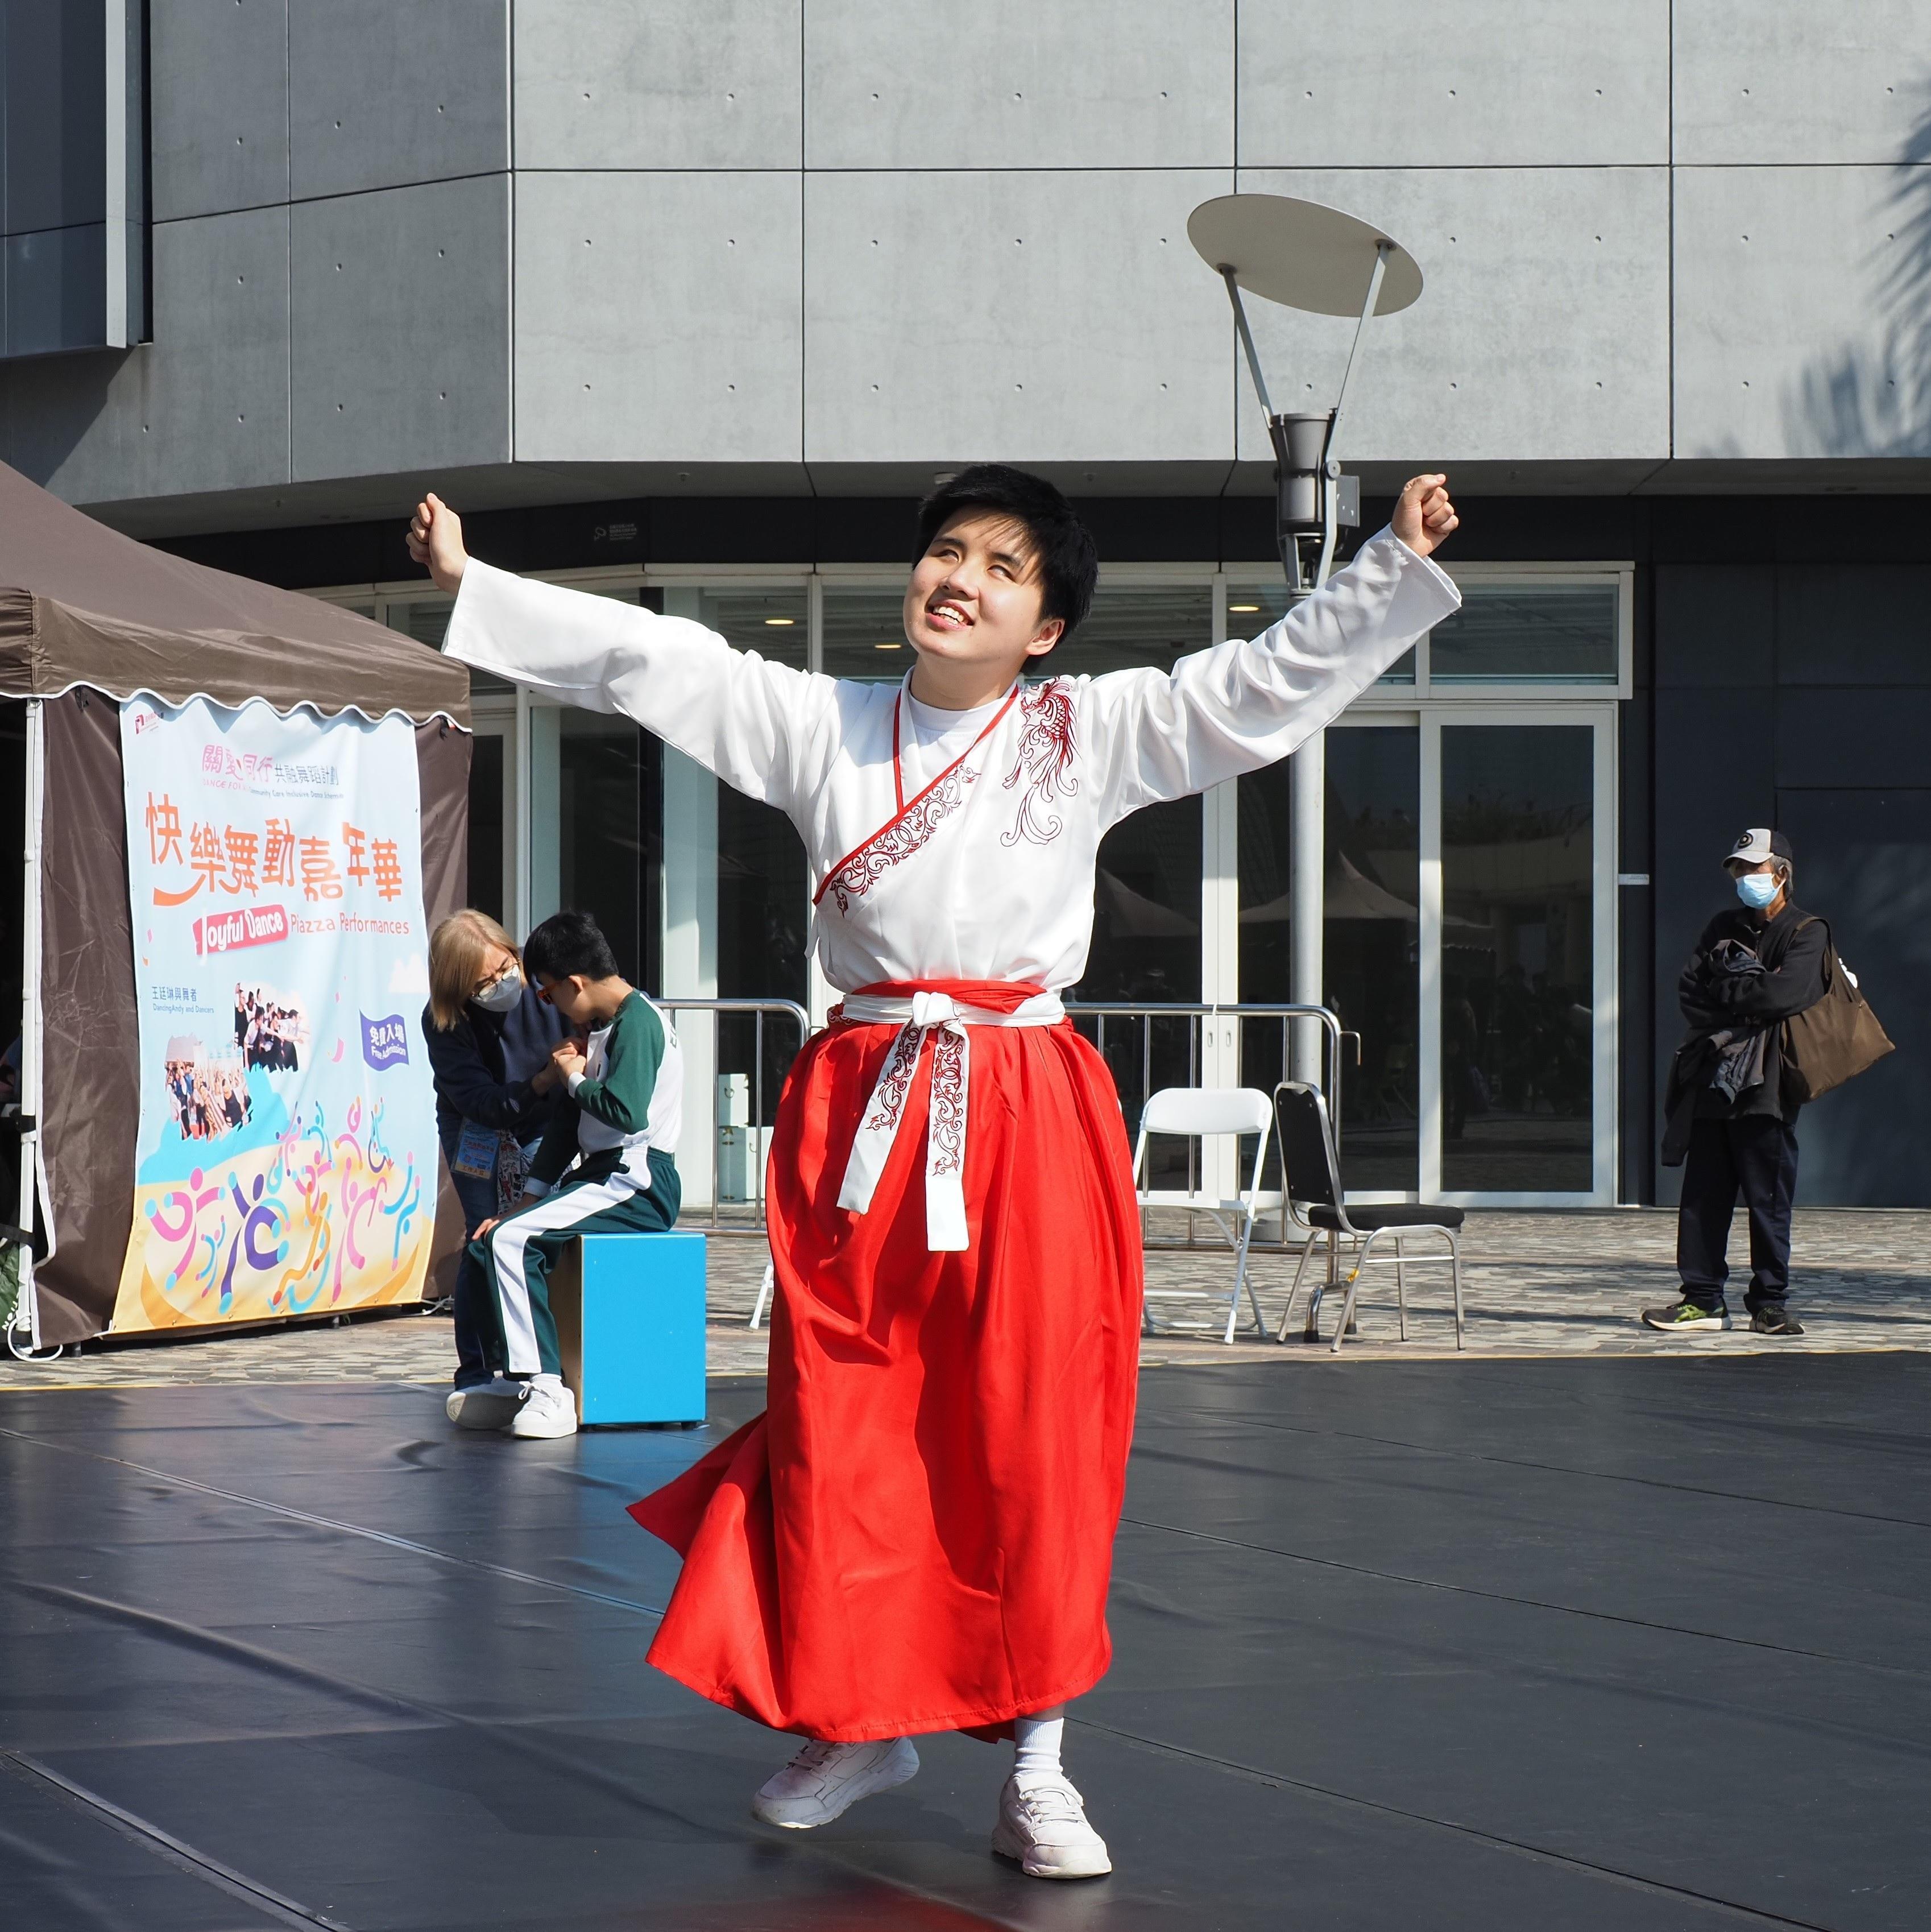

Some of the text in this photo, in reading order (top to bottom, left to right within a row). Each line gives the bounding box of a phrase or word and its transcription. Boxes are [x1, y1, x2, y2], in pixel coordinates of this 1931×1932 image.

[145, 791, 403, 905] 快樂舞動嘉年華
[200, 909, 410, 963] Joyful Dance Piazza Performances
[195, 1005, 214, 1013] Dancers
[369, 1023, 405, 1046] 免費入場
[371, 1042, 406, 1060] Free Admission
